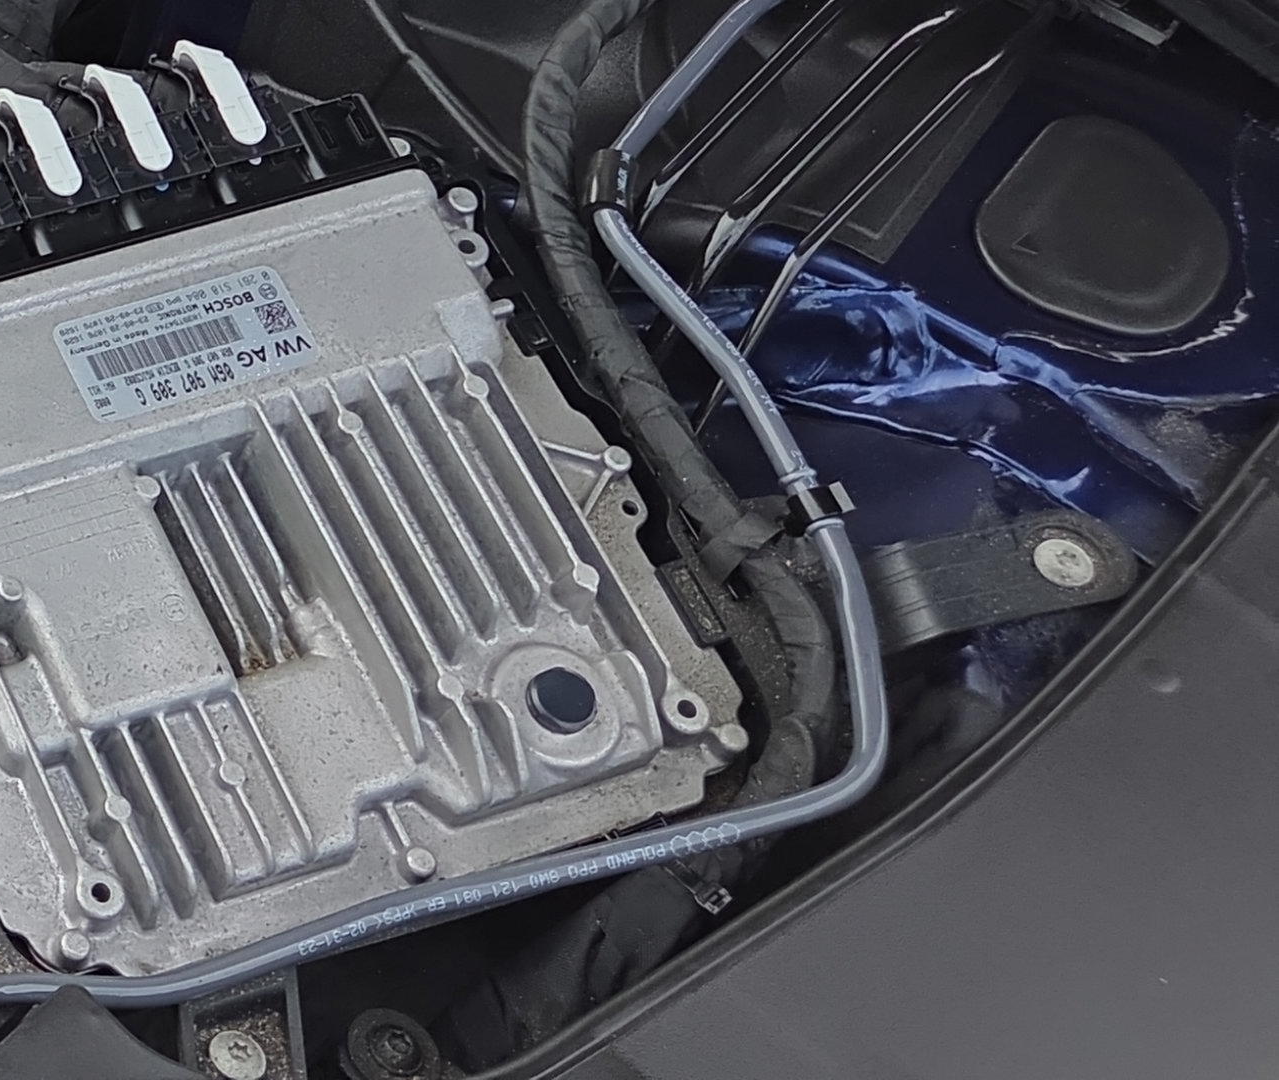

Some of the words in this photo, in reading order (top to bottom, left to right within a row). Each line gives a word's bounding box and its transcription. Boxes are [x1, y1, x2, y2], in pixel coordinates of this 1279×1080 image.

[155, 302, 199, 321] MOTRONIC
[201, 290, 255, 315] BOSCH
[111, 335, 122, 344] in
[123, 327, 149, 341] Made
[269, 332, 313, 358] VW
[67, 338, 111, 357] Germany
[232, 344, 272, 370] AG
[175, 369, 207, 394] 907
[205, 360, 237, 386] 06M
[132, 385, 149, 406] G
[147, 377, 178, 402] 309
[604, 841, 666, 869] POLAND
[489, 877, 521, 899] 121
[293, 918, 368, 956] 02-31-23
